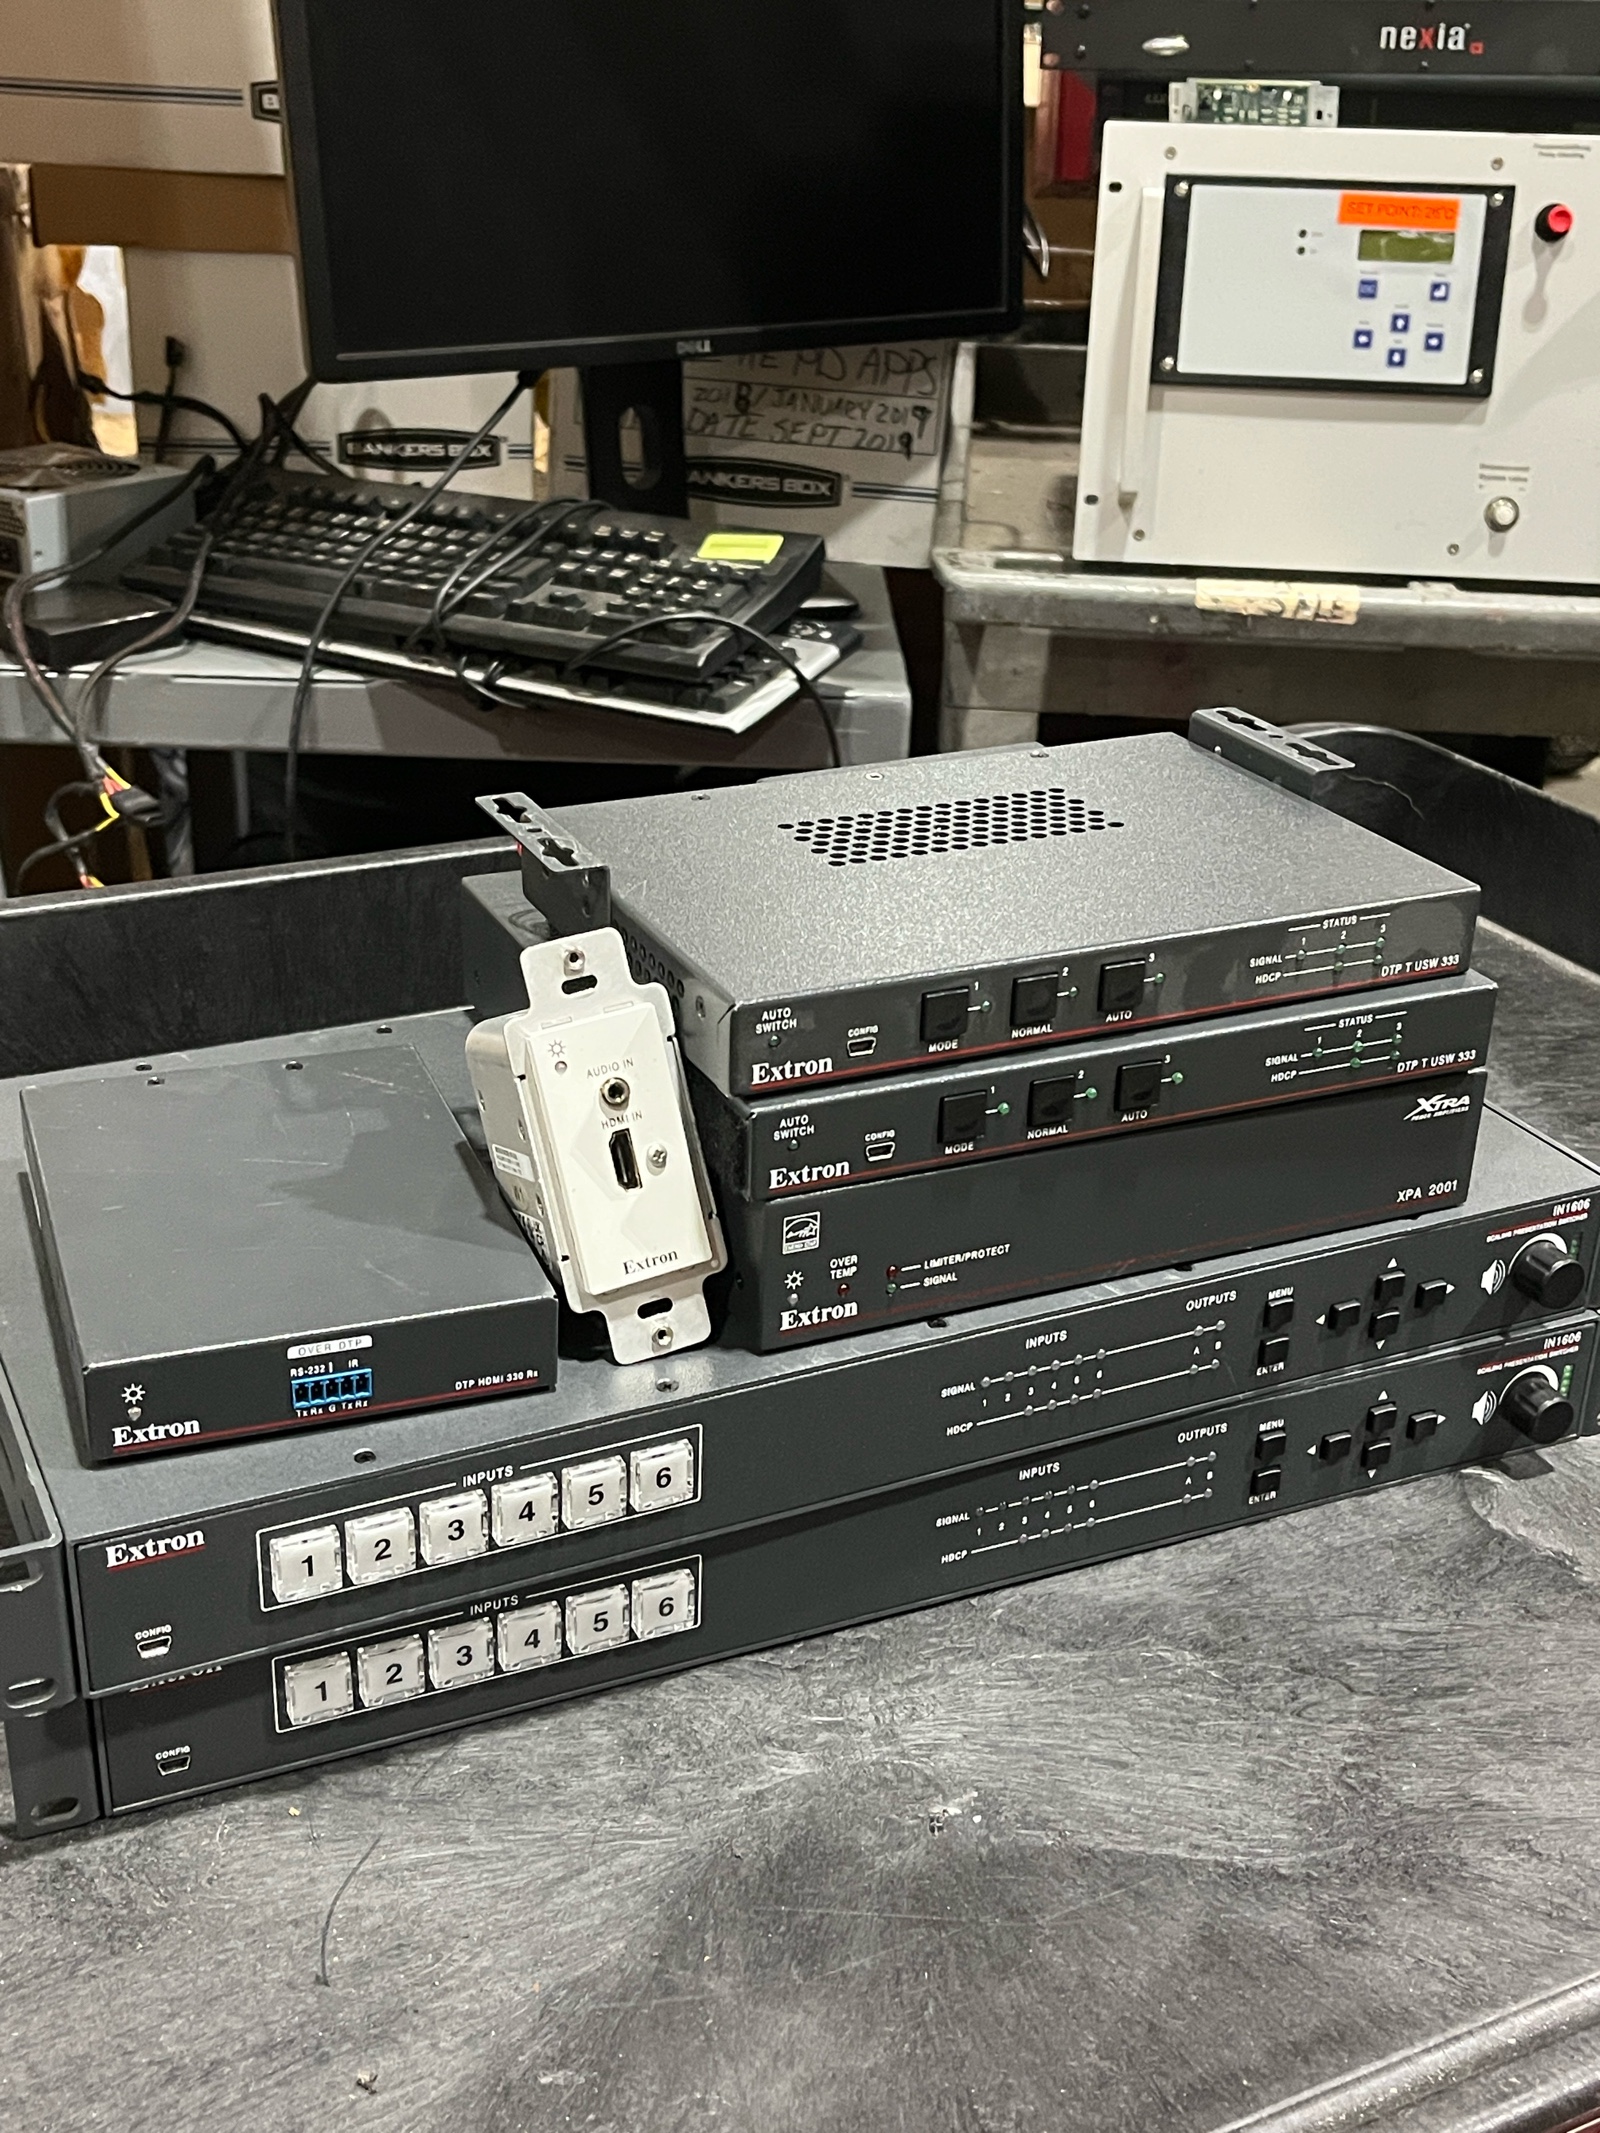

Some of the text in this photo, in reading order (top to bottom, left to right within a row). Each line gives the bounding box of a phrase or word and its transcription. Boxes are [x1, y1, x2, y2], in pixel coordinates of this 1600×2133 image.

[1380, 22, 1466, 50] nexia
[687, 470, 832, 496] ANKERS BOX
[1322, 915, 1358, 930] STATUS
[1301, 924, 1387, 946] 1 2 3
[1149, 953, 1156, 963] 3
[1249, 954, 1283, 968] SIGNAL
[1381, 954, 1460, 977] DTP T USW 333
[1062, 967, 1069, 977] 2
[1254, 971, 1282, 984] HDCP
[974, 981, 979, 991] 1
[762, 1007, 792, 1022] AUTO
[1105, 1011, 1133, 1023] AUTO
[1338, 1014, 1374, 1029] STATUS
[755, 1018, 798, 1034] SWITCH
[848, 1025, 879, 1038] CONFIG
[1011, 1024, 1054, 1039] NORMAL
[1317, 1036, 1322, 1045] 1
[1356, 1029, 1363, 1038] 2
[928, 1039, 959, 1053] MODE
[1164, 1055, 1171, 1064] 3
[1265, 1053, 1299, 1067] SIGNAL
[1397, 1050, 1477, 1073] DTP T USW 333
[587, 1058, 634, 1079] AUDIO IN
[751, 1057, 833, 1085] Extron
[1078, 1070, 1085, 1079] 2
[1270, 1070, 1297, 1083] HDCP
[991, 1086, 996, 1094] 1
[1403, 1094, 1470, 1121] XTRA
[601, 1110, 643, 1130] HDMI IN
[779, 1114, 809, 1129] AUTO
[1122, 1110, 1148, 1122] AUTO
[773, 1125, 815, 1141] SWITCH
[865, 1129, 896, 1142] CONFIG
[1027, 1125, 1069, 1140] NORMAL
[945, 1141, 975, 1155] MODE
[768, 1161, 851, 1190] Extron
[1397, 1180, 1458, 1203] XPA 2001
[1553, 1199, 1591, 1217] IN1606
[623, 1251, 678, 1276] Extron
[830, 1255, 858, 1269] OVER
[924, 1244, 1011, 1270] LIMITER/PROTECT
[830, 1266, 858, 1280] TEMP
[923, 1273, 958, 1287] SIGNAL
[1268, 1286, 1294, 1300] MENU
[1186, 1291, 1237, 1312] OUTPUTS
[780, 1301, 859, 1331] Extron
[1026, 1330, 1068, 1350] INPUTS
[1544, 1332, 1582, 1350] IN1606
[298, 1339, 362, 1357] OVER DTP
[290, 1365, 326, 1377] RS-232
[348, 1359, 359, 1368] IR
[1256, 1361, 1285, 1376] ENTER
[455, 1380, 475, 1391] DTP
[478, 1375, 504, 1387] HDMI
[506, 1372, 524, 1382] 330
[941, 1382, 976, 1399] SIGNAL
[329, 1404, 336, 1413] G
[946, 1422, 974, 1437] HDCP
[1259, 1419, 1285, 1432] MENU
[112, 1420, 201, 1448] Extron
[1177, 1423, 1228, 1444] OUTPUTS
[462, 1466, 515, 1489] INPUTS
[1019, 1462, 1061, 1481] INPUTS
[301, 1467, 672, 1578] 1 2 3 4 5 6
[936, 1513, 971, 1528] SIGNAL
[105, 1529, 205, 1568] Extron
[941, 1550, 968, 1564] HDCP
[469, 1595, 519, 1616] INPUTS
[135, 1624, 172, 1640] CONFIG
[314, 1597, 676, 1702] 1 2 3 4 5 6
[155, 1746, 191, 1761] CONFIG
